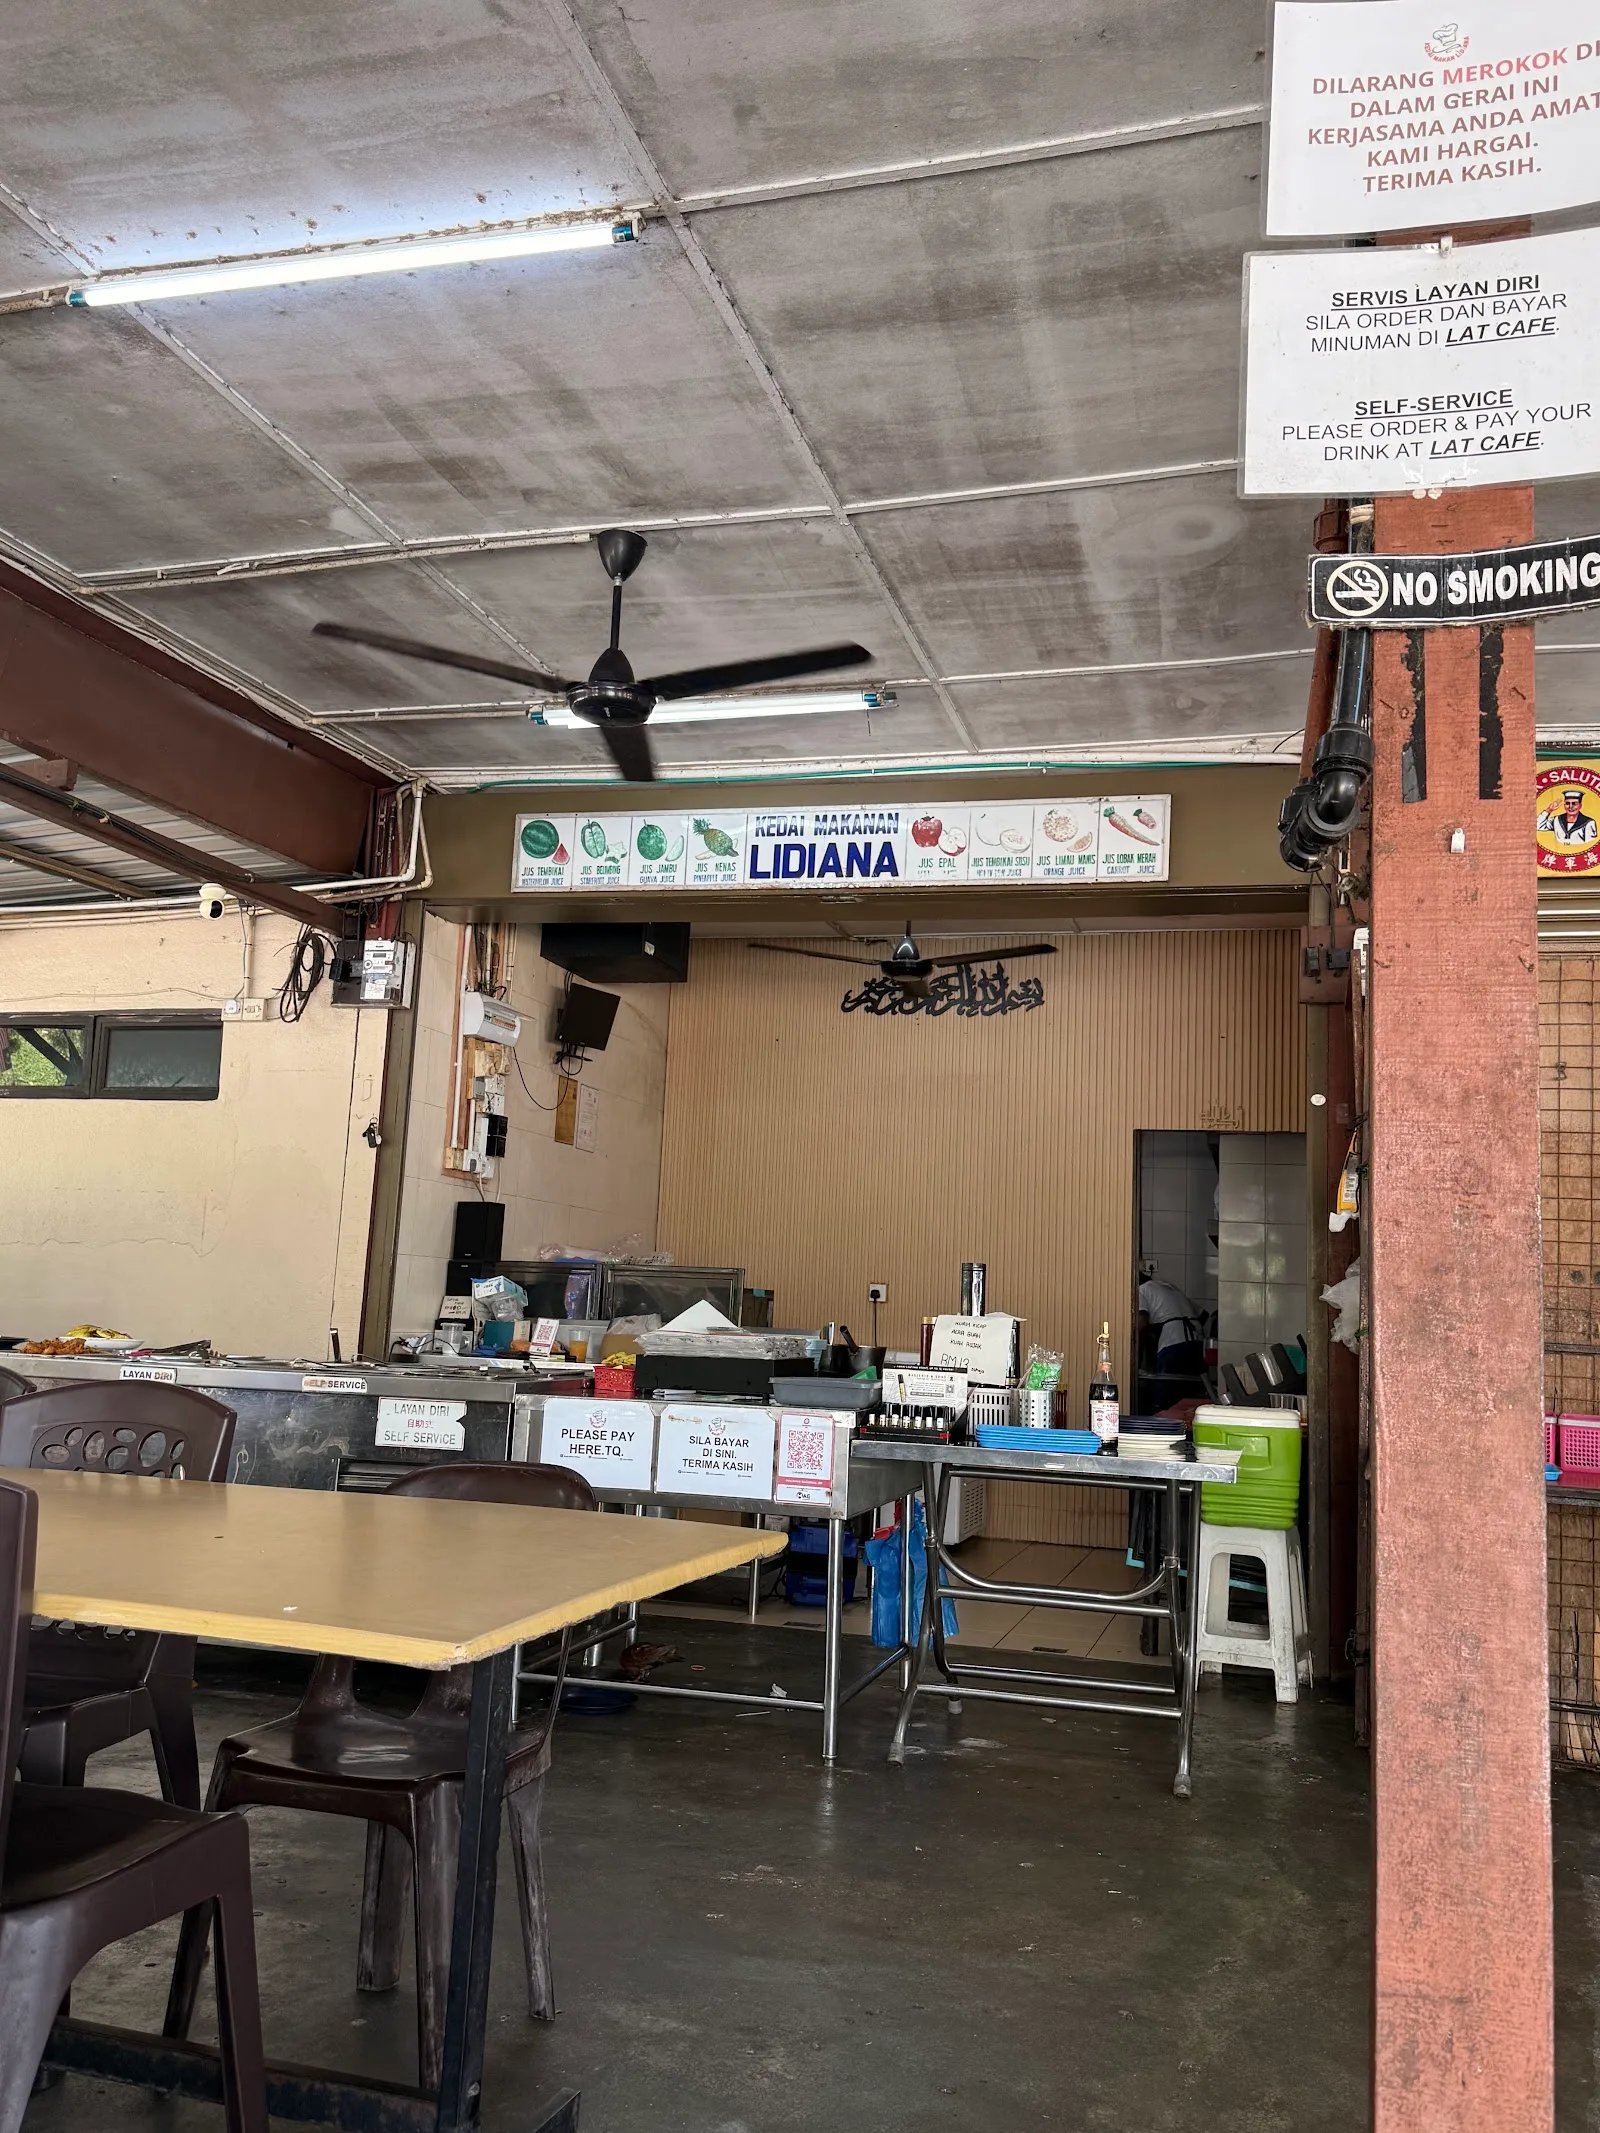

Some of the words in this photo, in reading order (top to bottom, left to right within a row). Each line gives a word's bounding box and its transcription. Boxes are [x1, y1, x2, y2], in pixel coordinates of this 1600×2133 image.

[1312, 71, 1434, 94] DILARANG
[1443, 47, 1568, 85] MEROKOK
[1350, 95, 1435, 118] DALAM
[1444, 84, 1514, 110] GERAI
[1524, 75, 1559, 98] INI
[1308, 119, 1444, 147] KERJASAMA
[1451, 108, 1524, 133] ANDA
[1531, 93, 1600, 122] AMAT
[1367, 146, 1429, 167] KAMI
[1437, 132, 1539, 160] HARGAI.
[1363, 169, 1453, 193] TERIMA
[1462, 157, 1542, 182] KASIH.
[1332, 289, 1408, 308] SERVIS
[1415, 280, 1488, 303] LAYAN
[1496, 274, 1540, 294] DIRI
[1306, 311, 1350, 331] SILA
[1358, 308, 1433, 329] ORDER
[1440, 303, 1485, 323] DAN
[1492, 293, 1568, 315] BAYAR
[1310, 332, 1411, 353] MINUMAN
[1418, 330, 1439, 347] DI
[1446, 323, 1490, 345] LAT
[1495, 316, 1560, 339] CAFE.
[1354, 388, 1514, 418] SELF-SERVICE
[1282, 420, 1363, 441] PLEASE
[1370, 416, 1447, 437] ORDER
[1454, 415, 1468, 431] &
[1475, 411, 1520, 430] PAY
[1526, 402, 1592, 424] YOUR
[1324, 444, 1391, 461] DRINK
[1393, 440, 1424, 460] AT
[1430, 437, 1475, 457] LAT
[1480, 430, 1544, 453] CAFE.
[1393, 572, 1438, 606] NO
[1448, 551, 1600, 606] SMOKING
[755, 815, 805, 837] KEDAI
[814, 813, 899, 836] MAKANAN
[750, 842, 899, 879] LIDIANA
[918, 858, 934, 868] JUS
[938, 858, 956, 868] EPAL
[971, 858, 984, 867] JUS
[986, 857, 1014, 867] TEMBIKAI
[1015, 856, 1030, 866] SUSU
[1036, 856, 1050, 866] JUS
[1055, 855, 1074, 865] LIMAU
[1102, 854, 1115, 864] JUS
[1116, 854, 1134, 864] LOBAK
[1136, 853, 1156, 864] MERAH
[522, 867, 534, 876] JUS
[538, 866, 564, 876] TEMBIKAI
[580, 866, 592, 875] JUS
[640, 864, 652, 874] JUS
[656, 864, 678, 874] JAMBU
[694, 863, 708, 872] JUS
[715, 862, 736, 872] NENAS
[1044, 868, 1064, 876] ORANGE
[1068, 866, 1086, 876] JUICE
[1137, 865, 1156, 874] JUICE
[640, 876, 658, 884] GUAVA
[660, 875, 675, 883] JUICE
[720, 874, 737, 882] JUICE
[122, 1370, 152, 1378] LAYAN
[154, 1372, 172, 1380] DIRI
[328, 1380, 366, 1390] SERVICE
[394, 1402, 425, 1415] LAYAN
[430, 1405, 450, 1416] DIRI
[384, 1430, 410, 1442] SELF
[414, 1432, 456, 1444] SERVICE
[561, 1428, 608, 1440] PLEASE
[610, 1430, 635, 1442] PAY
[689, 1436, 712, 1446] SILA
[714, 1438, 750, 1448] BAYAR
[702, 1448, 712, 1457] DI
[715, 1449, 737, 1459] SINI.
[682, 1458, 720, 1470] TERIMA
[722, 1462, 754, 1472] KASIH
